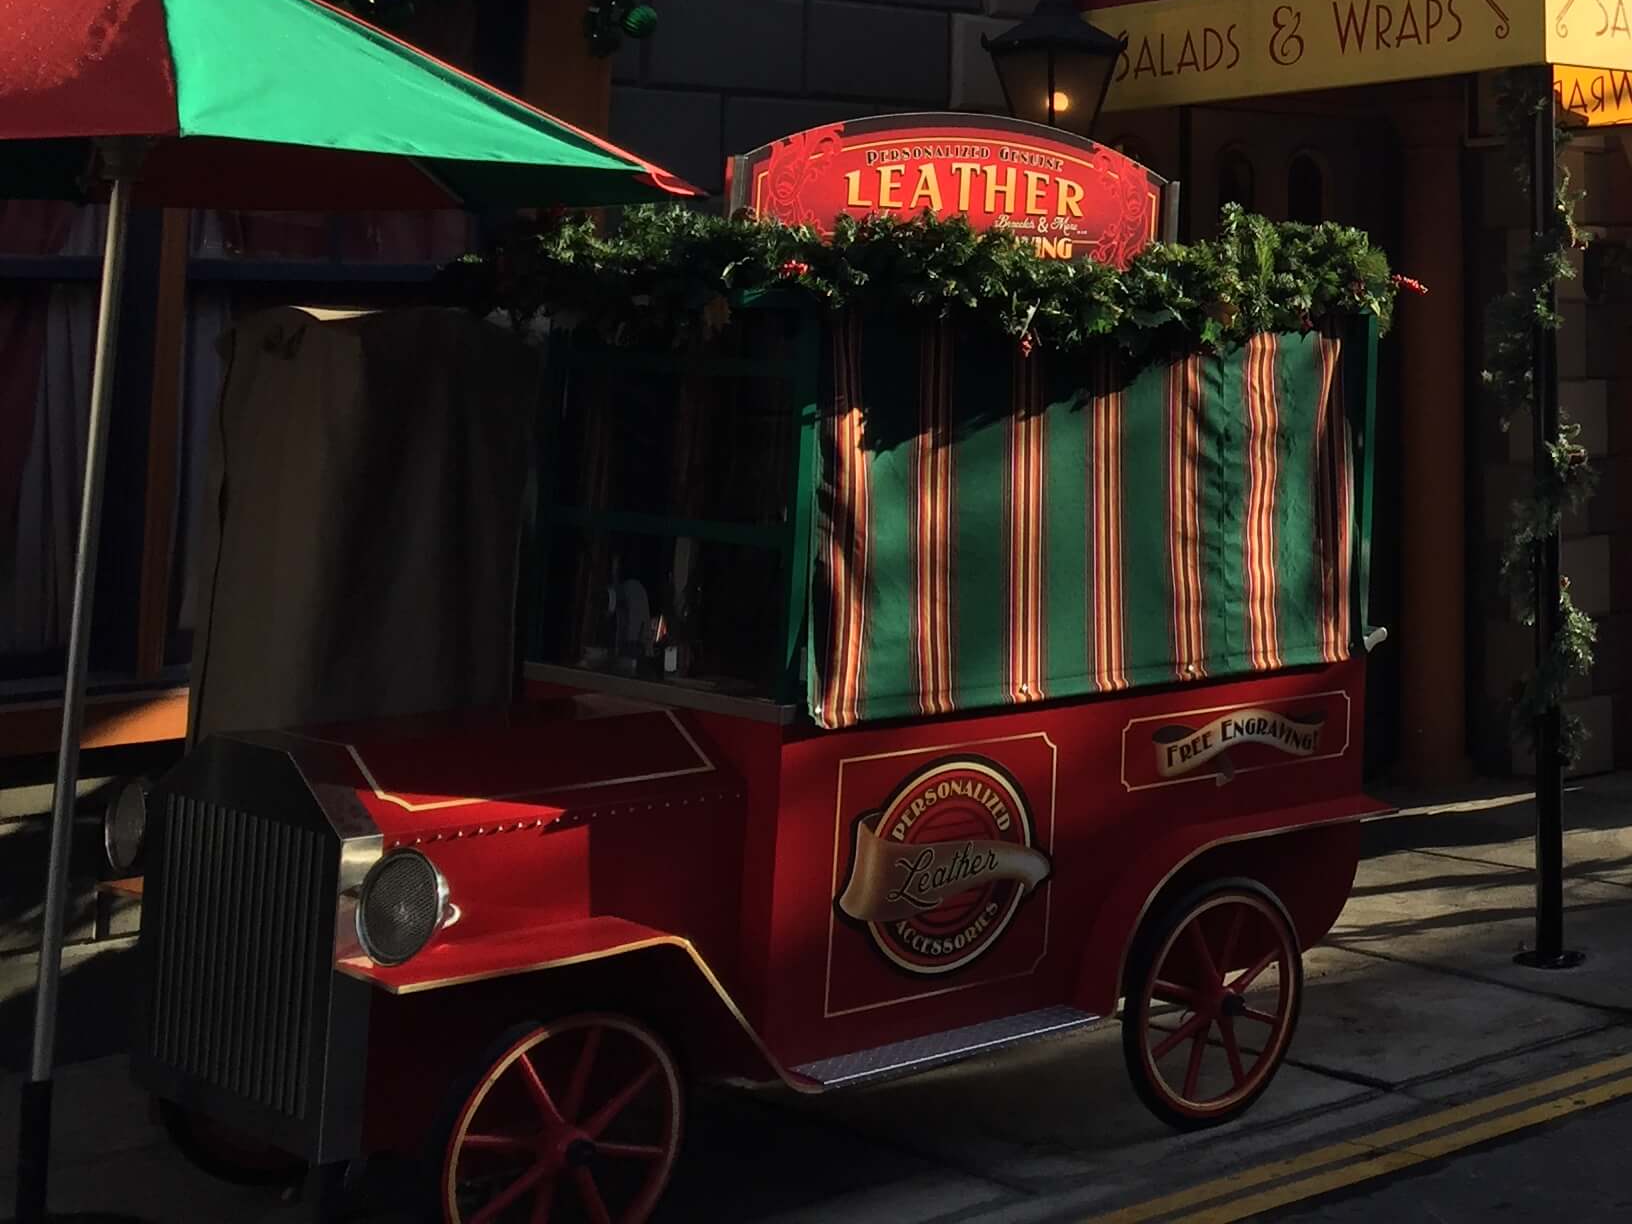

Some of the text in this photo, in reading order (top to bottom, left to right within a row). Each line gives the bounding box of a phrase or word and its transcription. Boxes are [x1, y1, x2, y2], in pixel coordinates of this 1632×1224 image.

[1268, 5, 1304, 66] &
[845, 162, 1085, 217] LEATHER
[1037, 217, 1049, 233] &
[1165, 710, 1319, 768] FREE ENGRAVING!
[892, 778, 1012, 841] PERSONALIZED
[886, 842, 998, 908] Leather
[893, 901, 999, 956] ACCESSORIES
